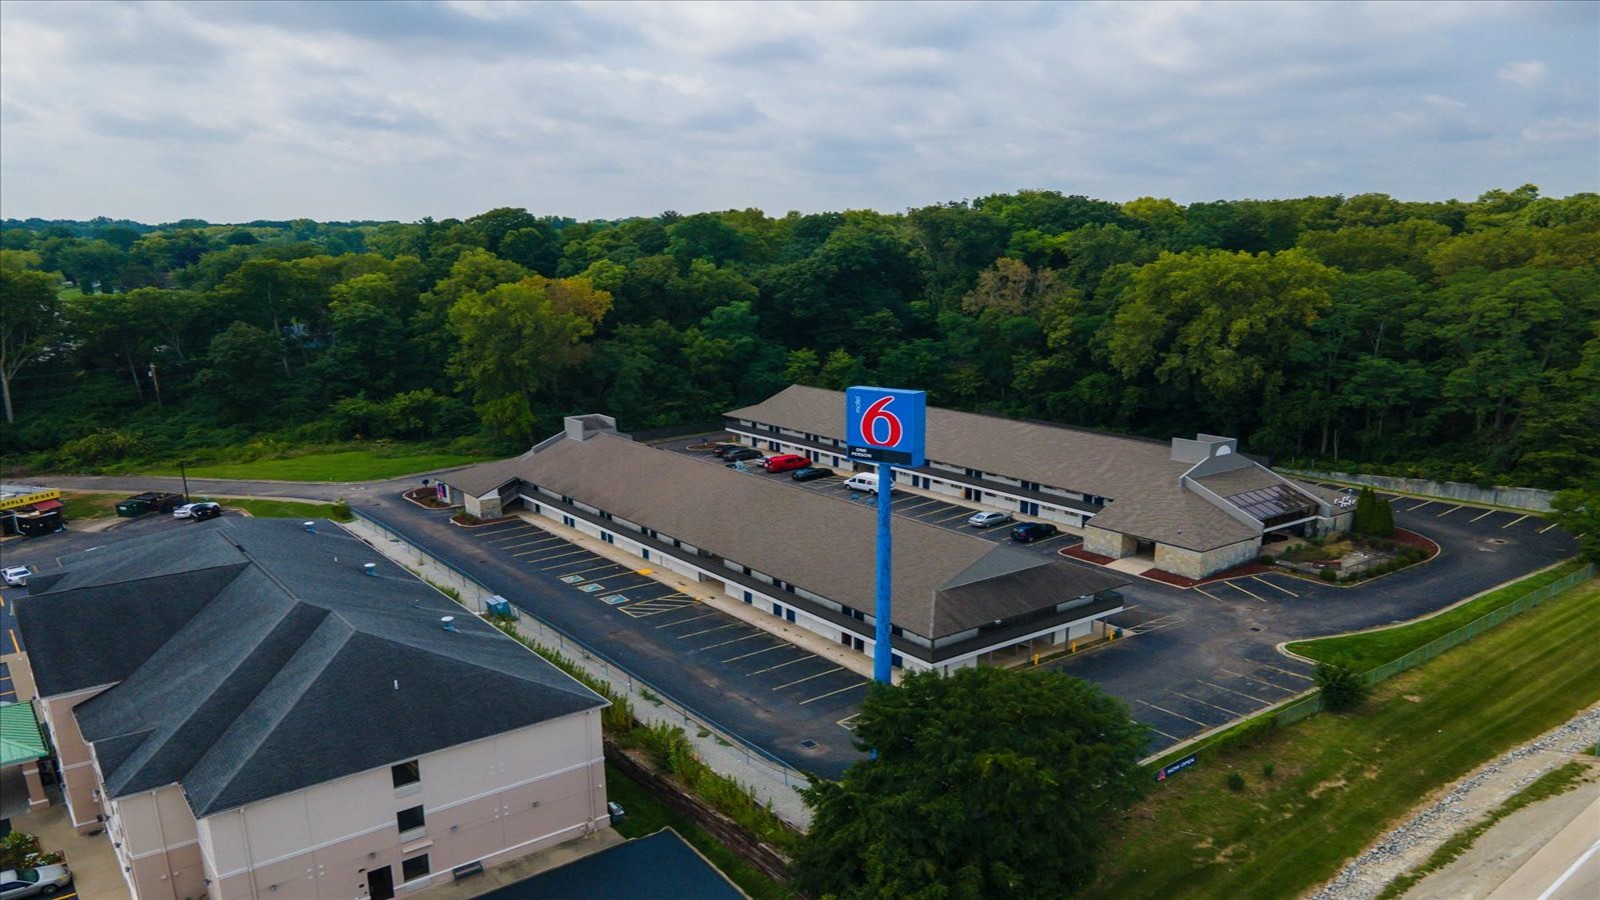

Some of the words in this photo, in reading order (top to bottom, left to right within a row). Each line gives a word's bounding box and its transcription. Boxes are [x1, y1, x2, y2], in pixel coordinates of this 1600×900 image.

[860, 395, 903, 447] 6
[1, 498, 24, 506] AFFLE
[29, 492, 54, 501] HOUSE
[1167, 764, 1180, 774] NOW
[1180, 757, 1195, 767] OPEN
